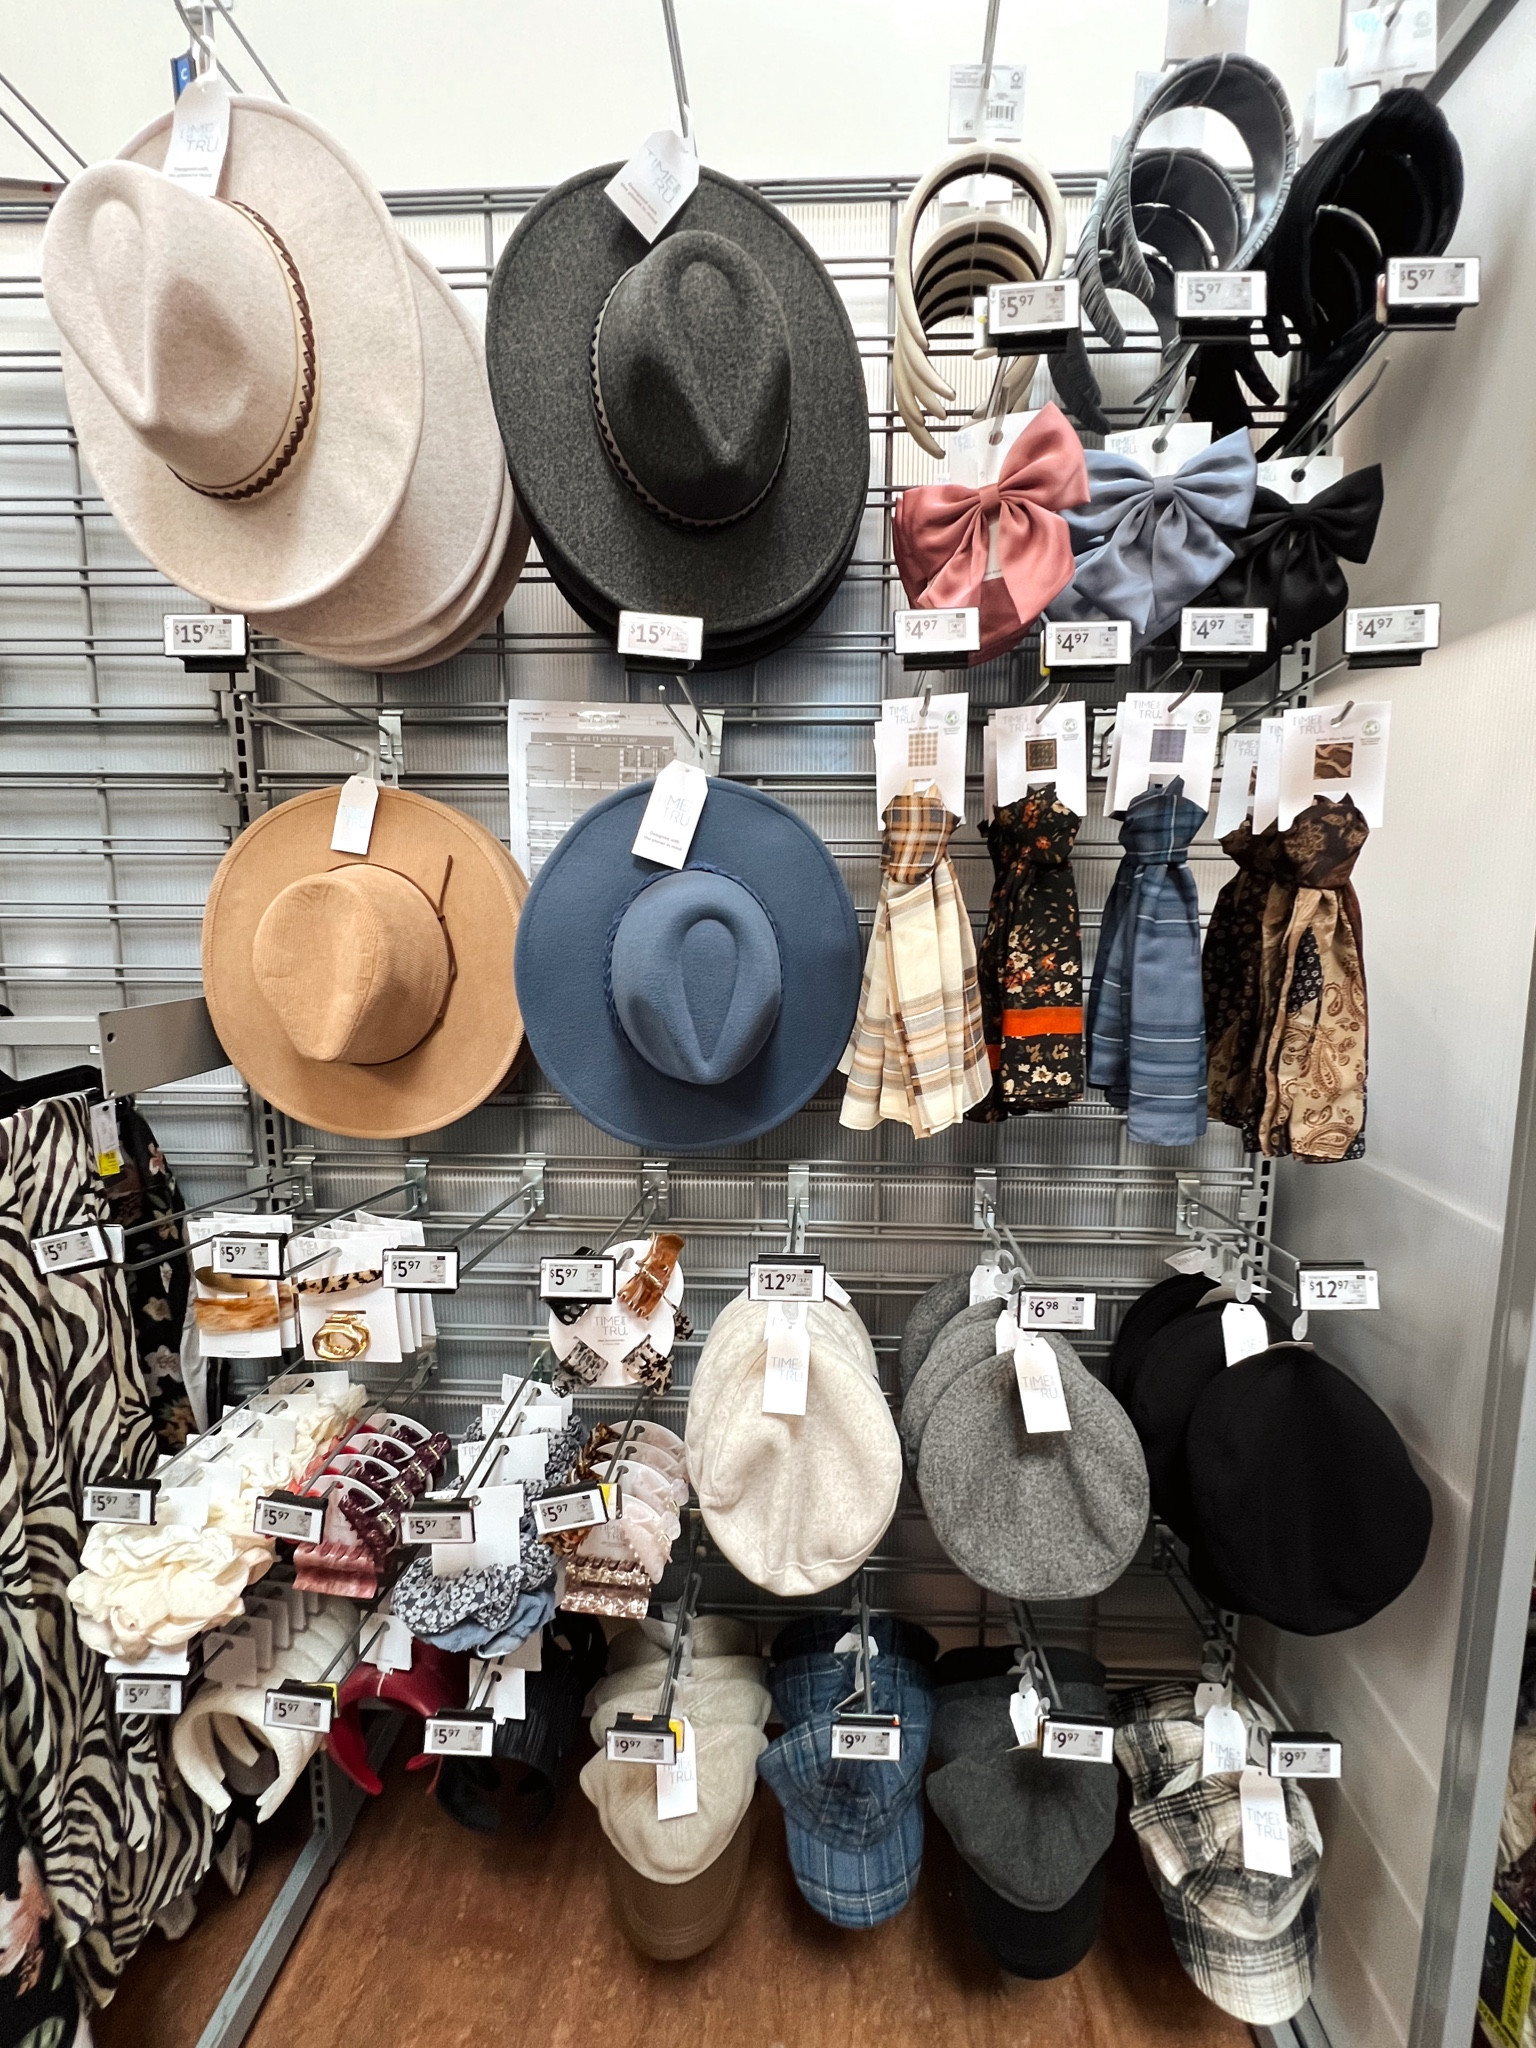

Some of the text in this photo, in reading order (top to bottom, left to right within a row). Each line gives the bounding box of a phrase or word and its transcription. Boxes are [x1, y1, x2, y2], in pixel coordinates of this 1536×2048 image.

[771, 1356, 799, 1370] TIME
[1021, 1375, 1050, 1388] TIME
[1247, 1807, 1276, 1825] TIME
